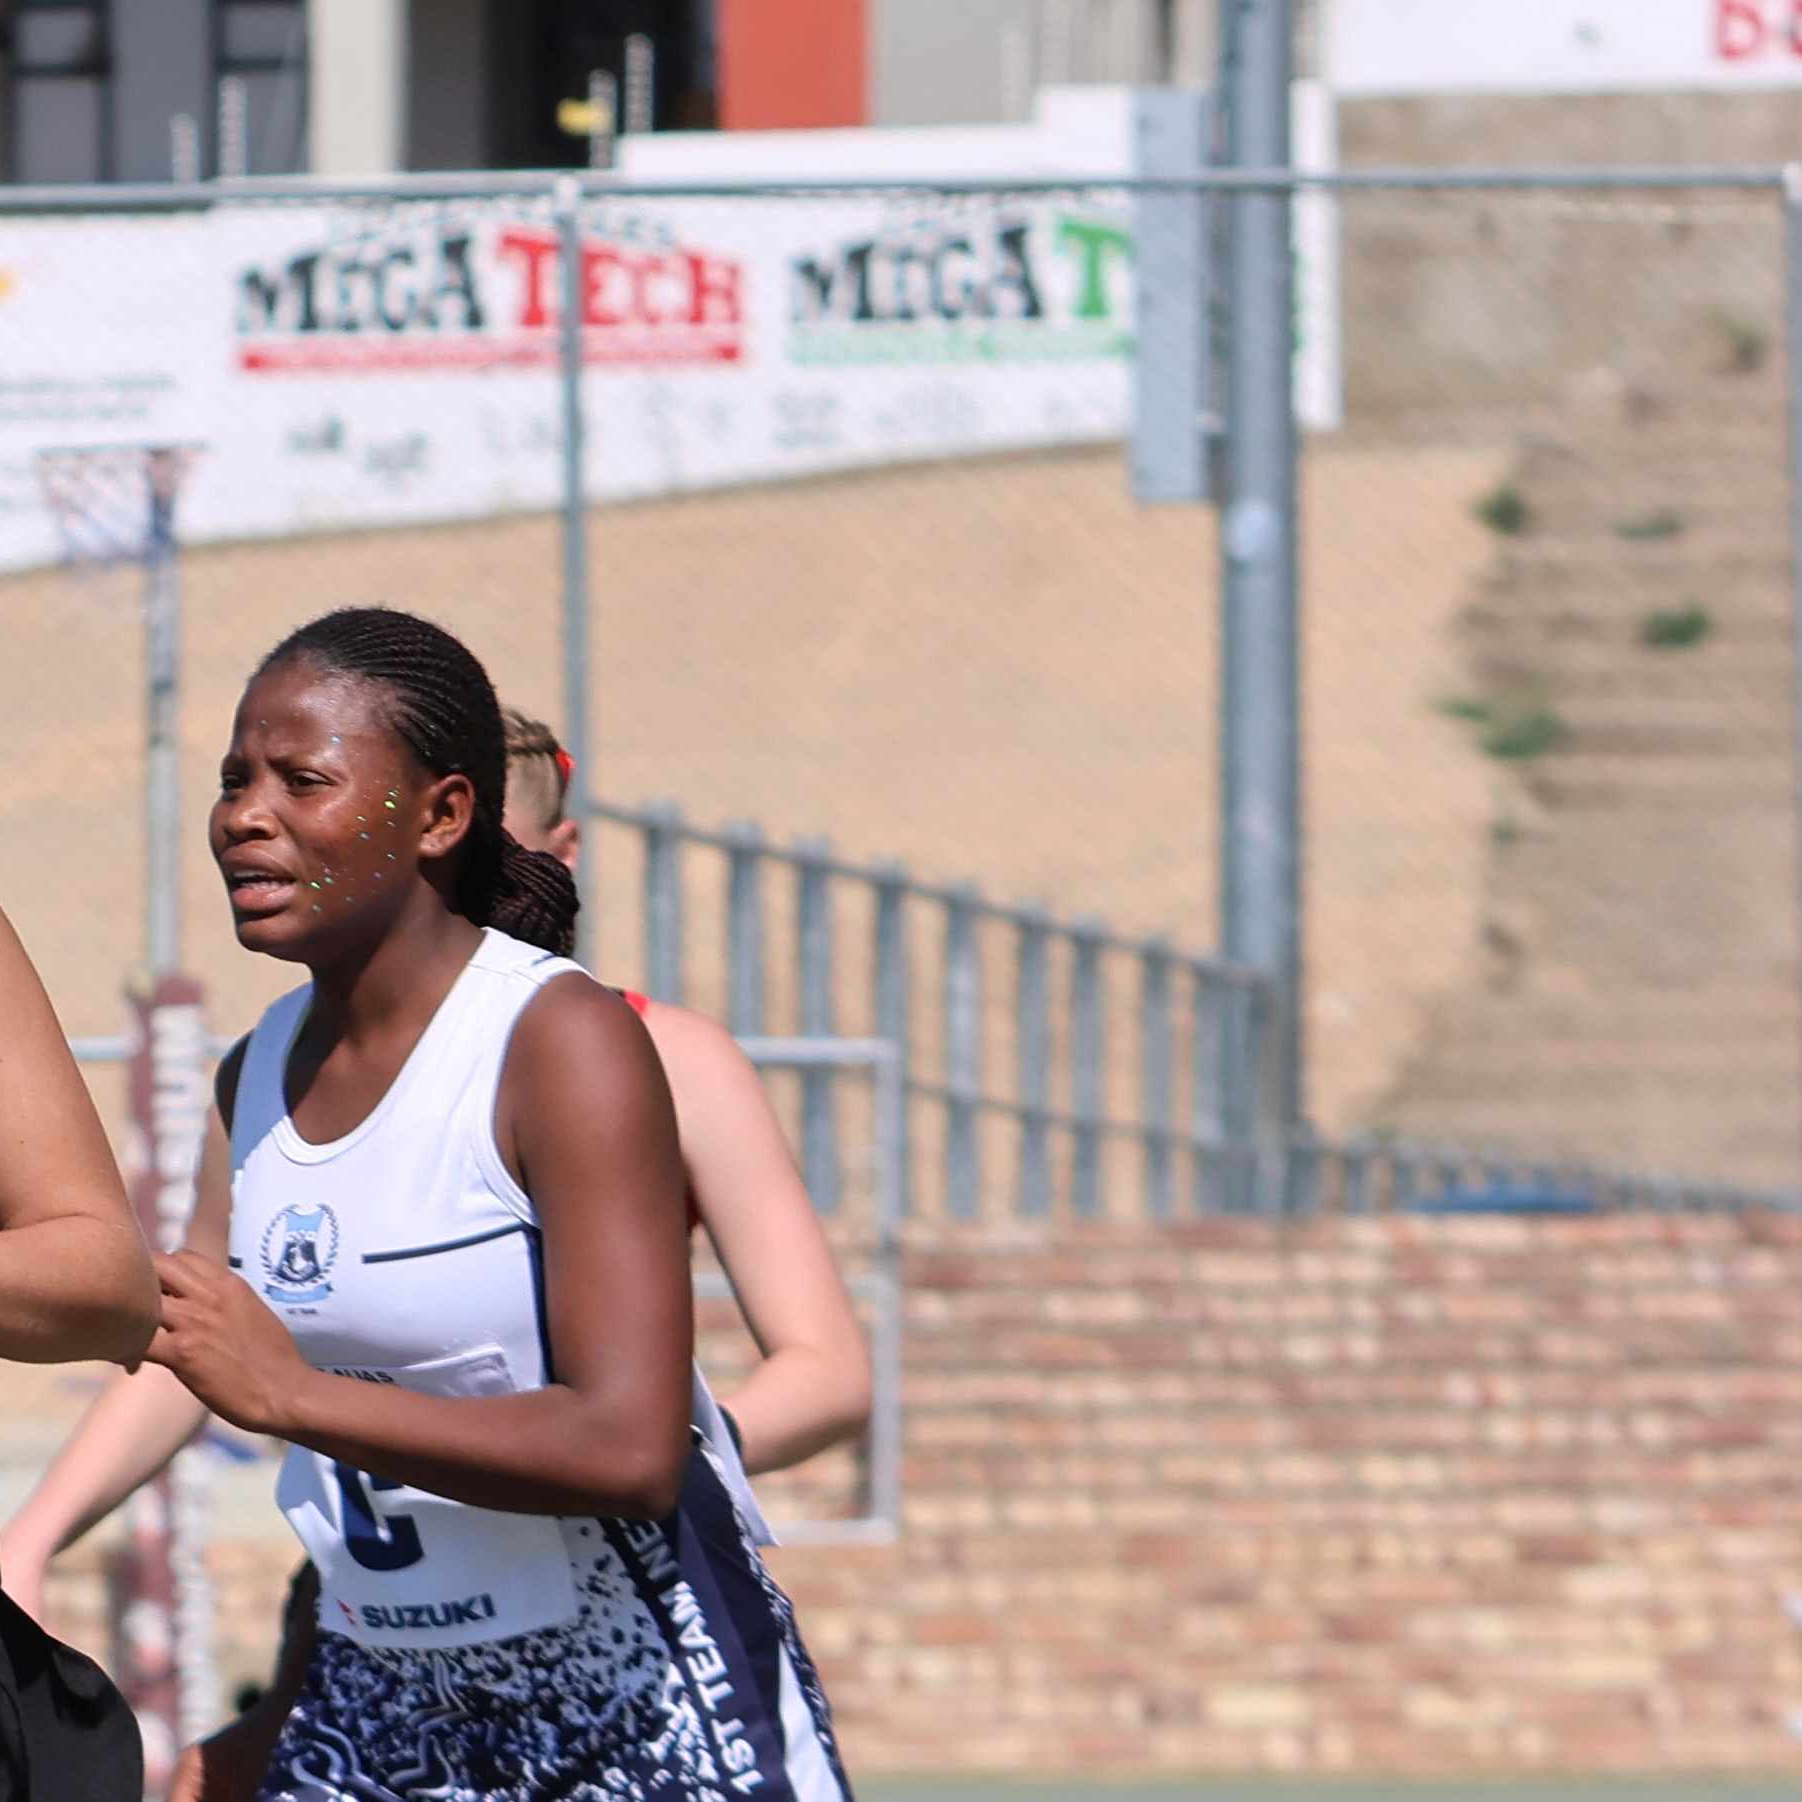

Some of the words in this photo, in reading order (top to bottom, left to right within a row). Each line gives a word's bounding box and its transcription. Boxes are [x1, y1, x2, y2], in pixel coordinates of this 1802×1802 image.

[237, 231, 482, 333] MEGA
[500, 224, 742, 328] TECH
[360, 1593, 496, 1629] SUZUKI
[657, 1580, 735, 1713] TEAM
[710, 1717, 764, 1796] 1ST
